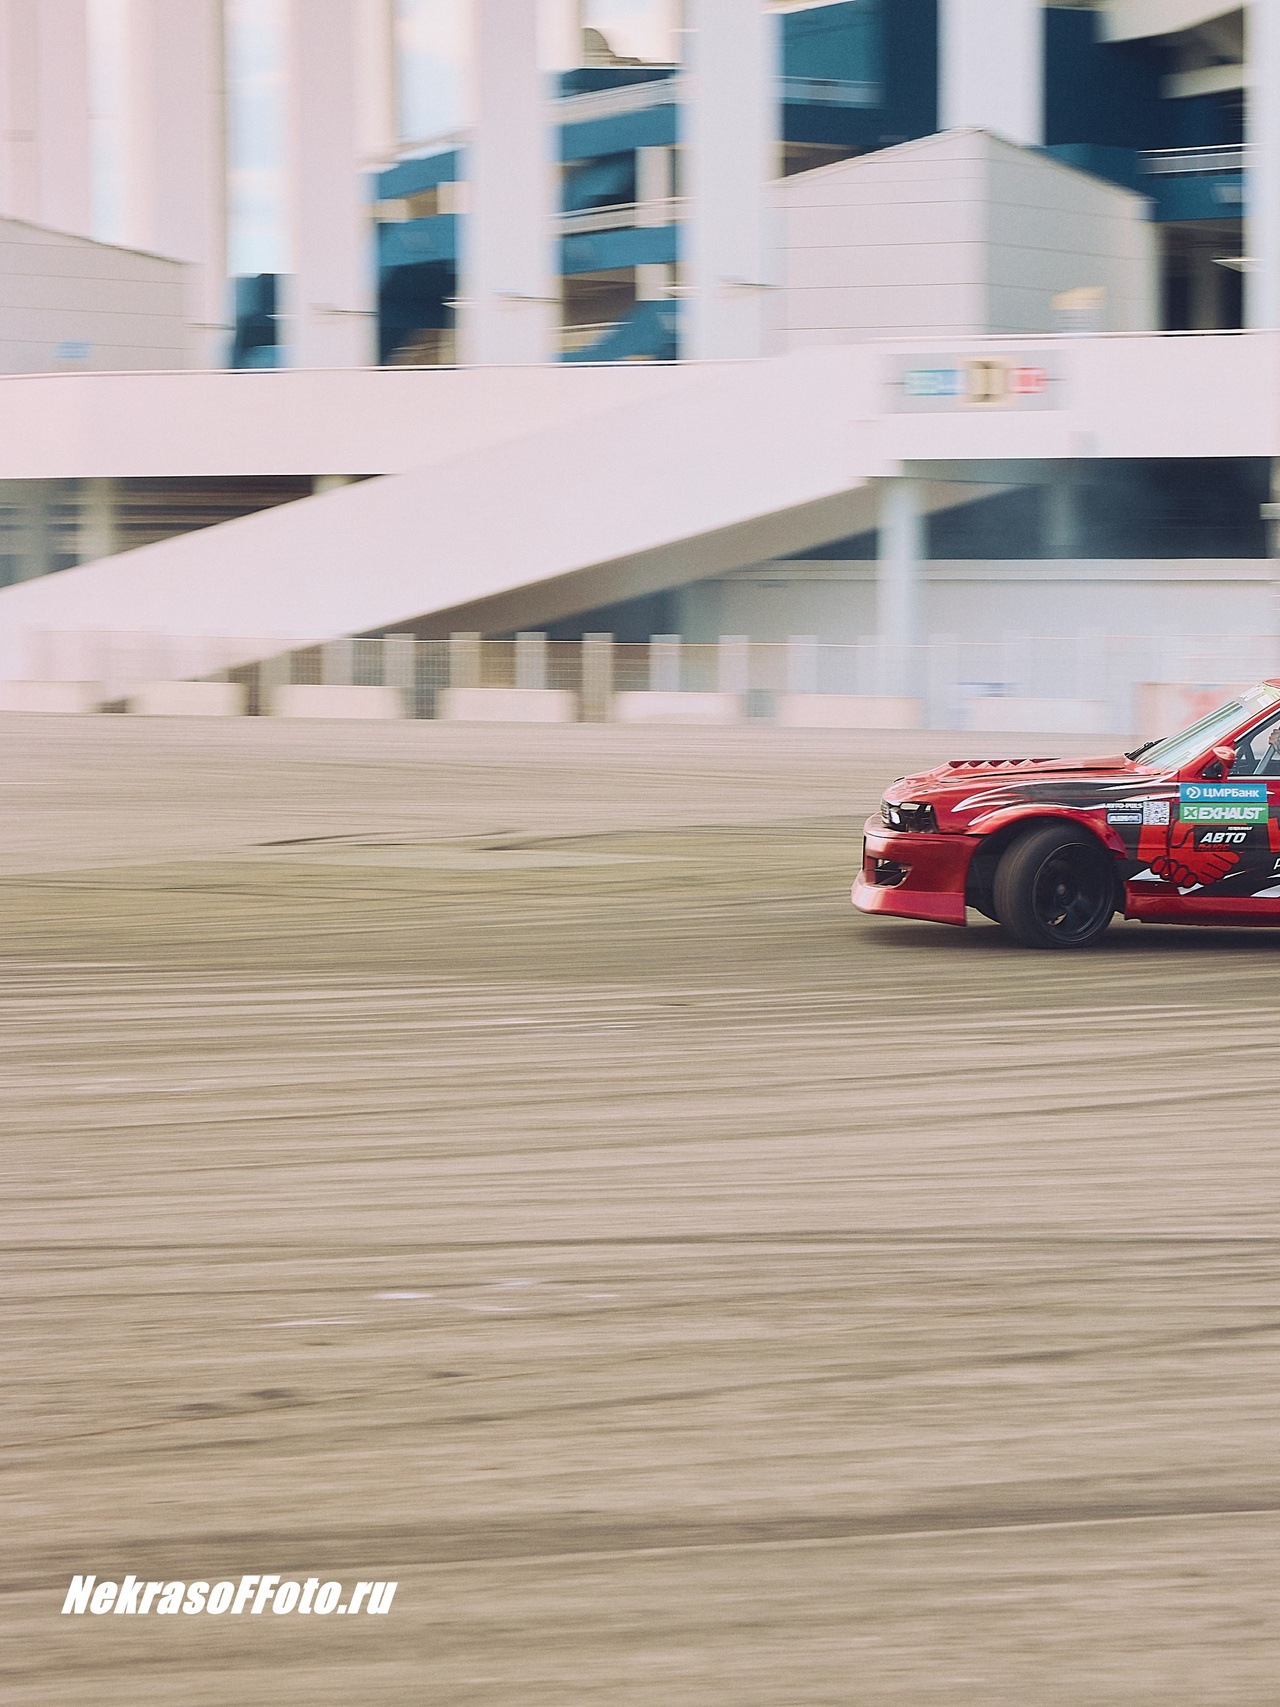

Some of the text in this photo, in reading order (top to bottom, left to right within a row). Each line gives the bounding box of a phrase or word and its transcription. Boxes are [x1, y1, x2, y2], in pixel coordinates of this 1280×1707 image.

[1203, 788, 1260, 798] ЦМРБанк
[1198, 807, 1266, 820] EXHAUST
[1200, 832, 1247, 843] АВТО
